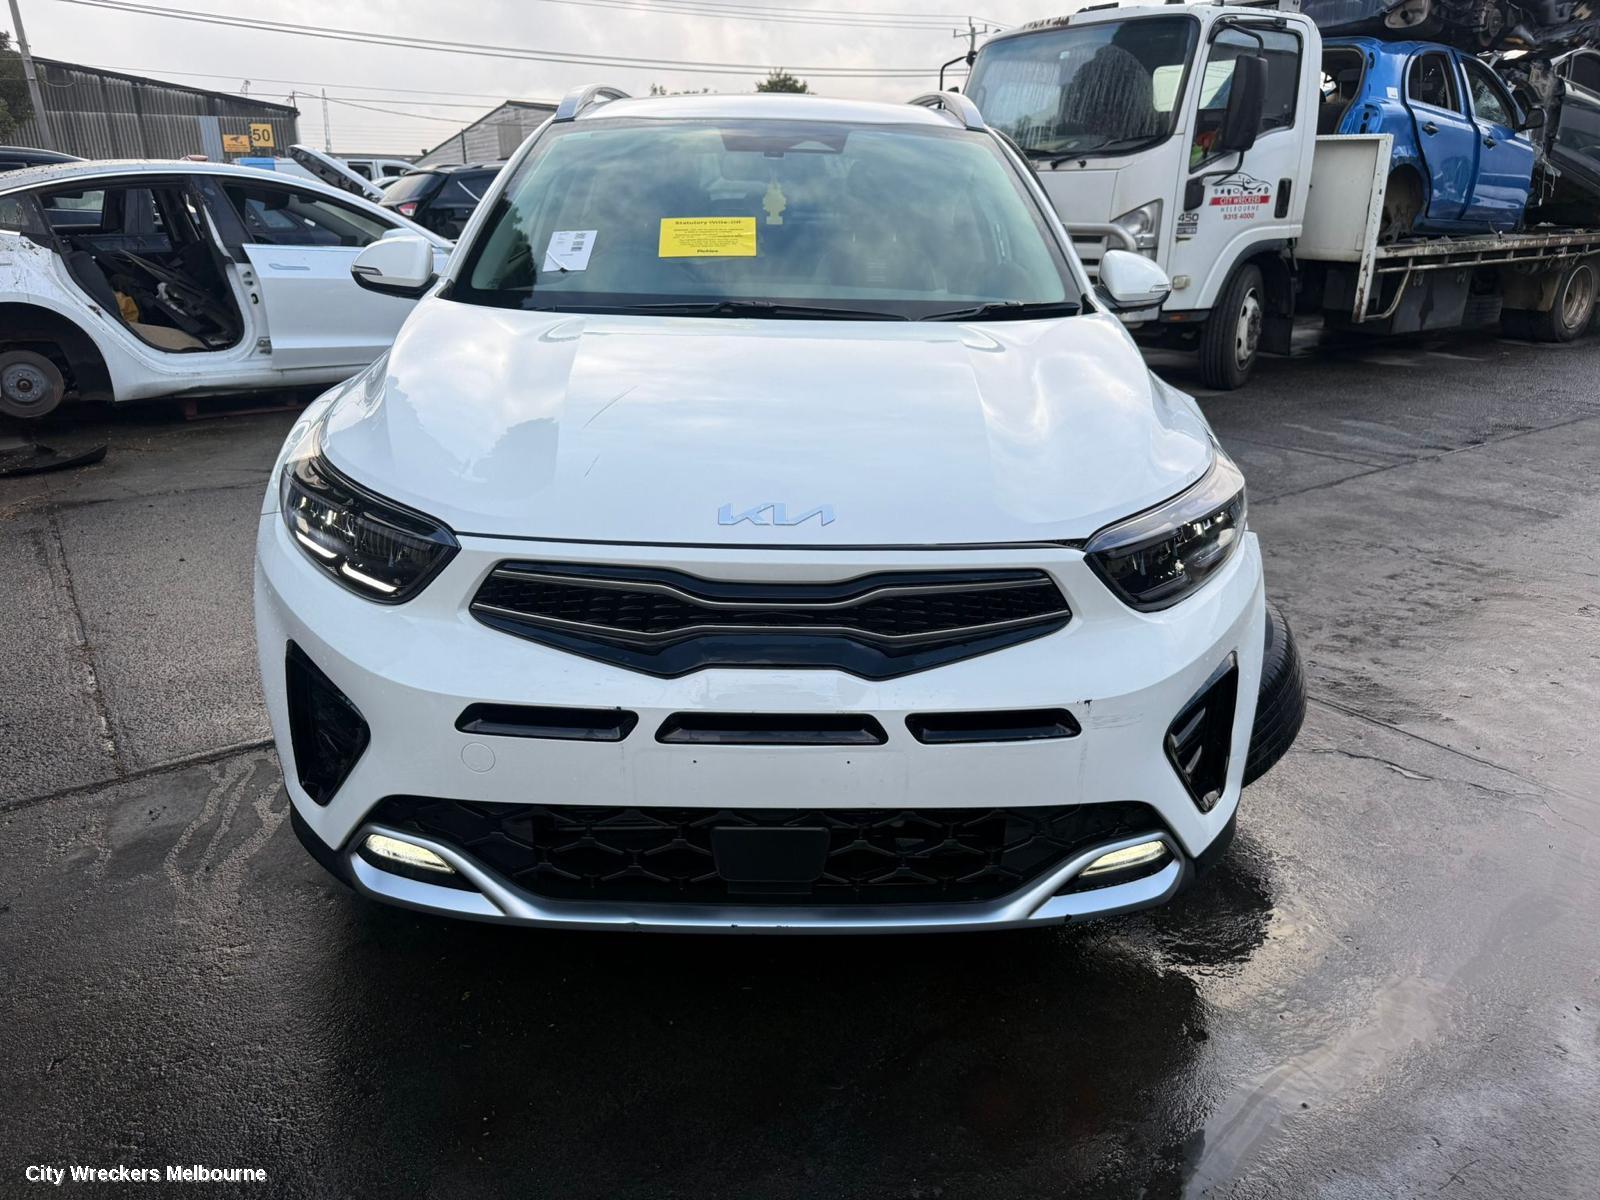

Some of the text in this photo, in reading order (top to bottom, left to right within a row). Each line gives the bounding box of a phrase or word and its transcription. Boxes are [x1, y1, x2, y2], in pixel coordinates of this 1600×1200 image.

[252, 129, 270, 141] 50
[1234, 195, 1260, 204] WRECKERS
[1178, 212, 1199, 221] 450
